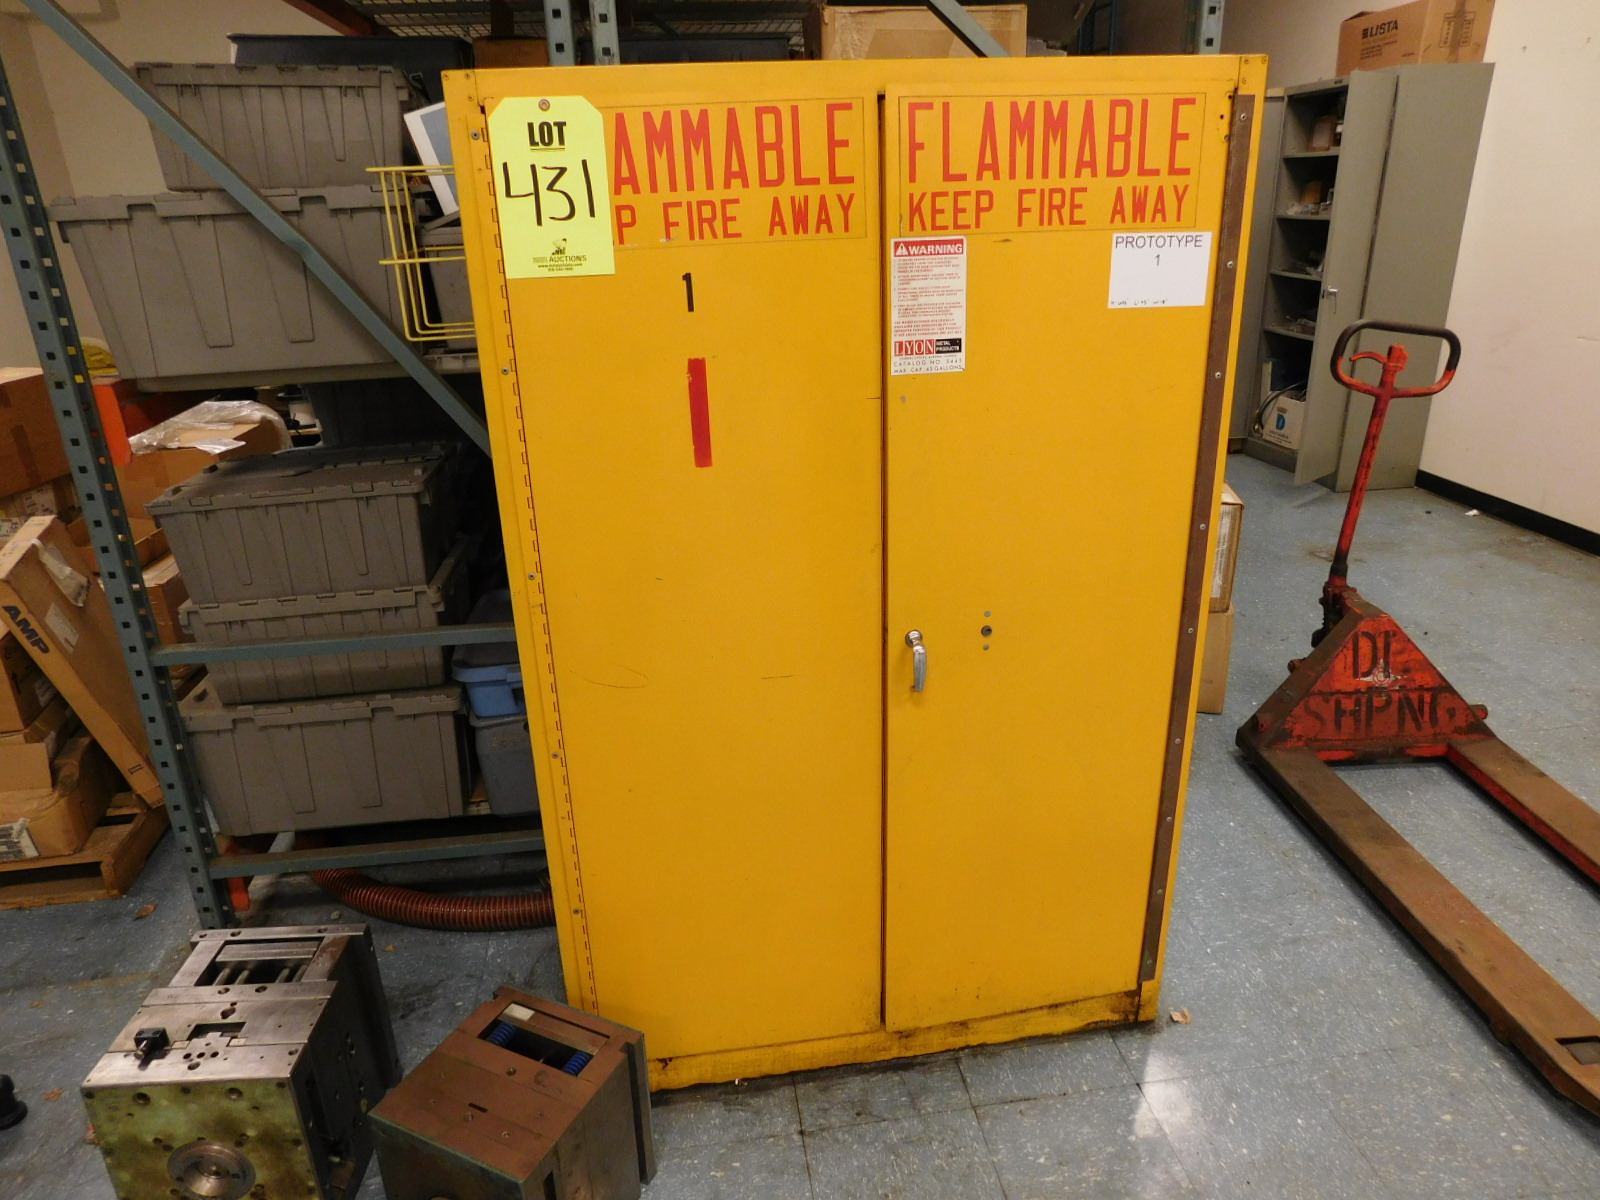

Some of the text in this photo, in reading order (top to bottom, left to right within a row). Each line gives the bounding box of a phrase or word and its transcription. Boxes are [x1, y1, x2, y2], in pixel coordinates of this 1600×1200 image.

[527, 121, 566, 147] LOT
[613, 103, 855, 195] AMMABLE
[908, 98, 1197, 183] FLAMMABLE
[502, 159, 595, 226] 431
[908, 184, 1190, 232] KEEP FIRE AWAY
[662, 198, 742, 241] FIRE
[768, 193, 855, 236] AWAY
[908, 243, 963, 255] WARNING
[1115, 235, 1203, 249] PROTOTYPE
[1155, 254, 1160, 266] 1
[682, 272, 694, 313] 1
[893, 360, 927, 368] CATALOG
[895, 340, 934, 356] LYON
[2, 605, 50, 654] AMP
